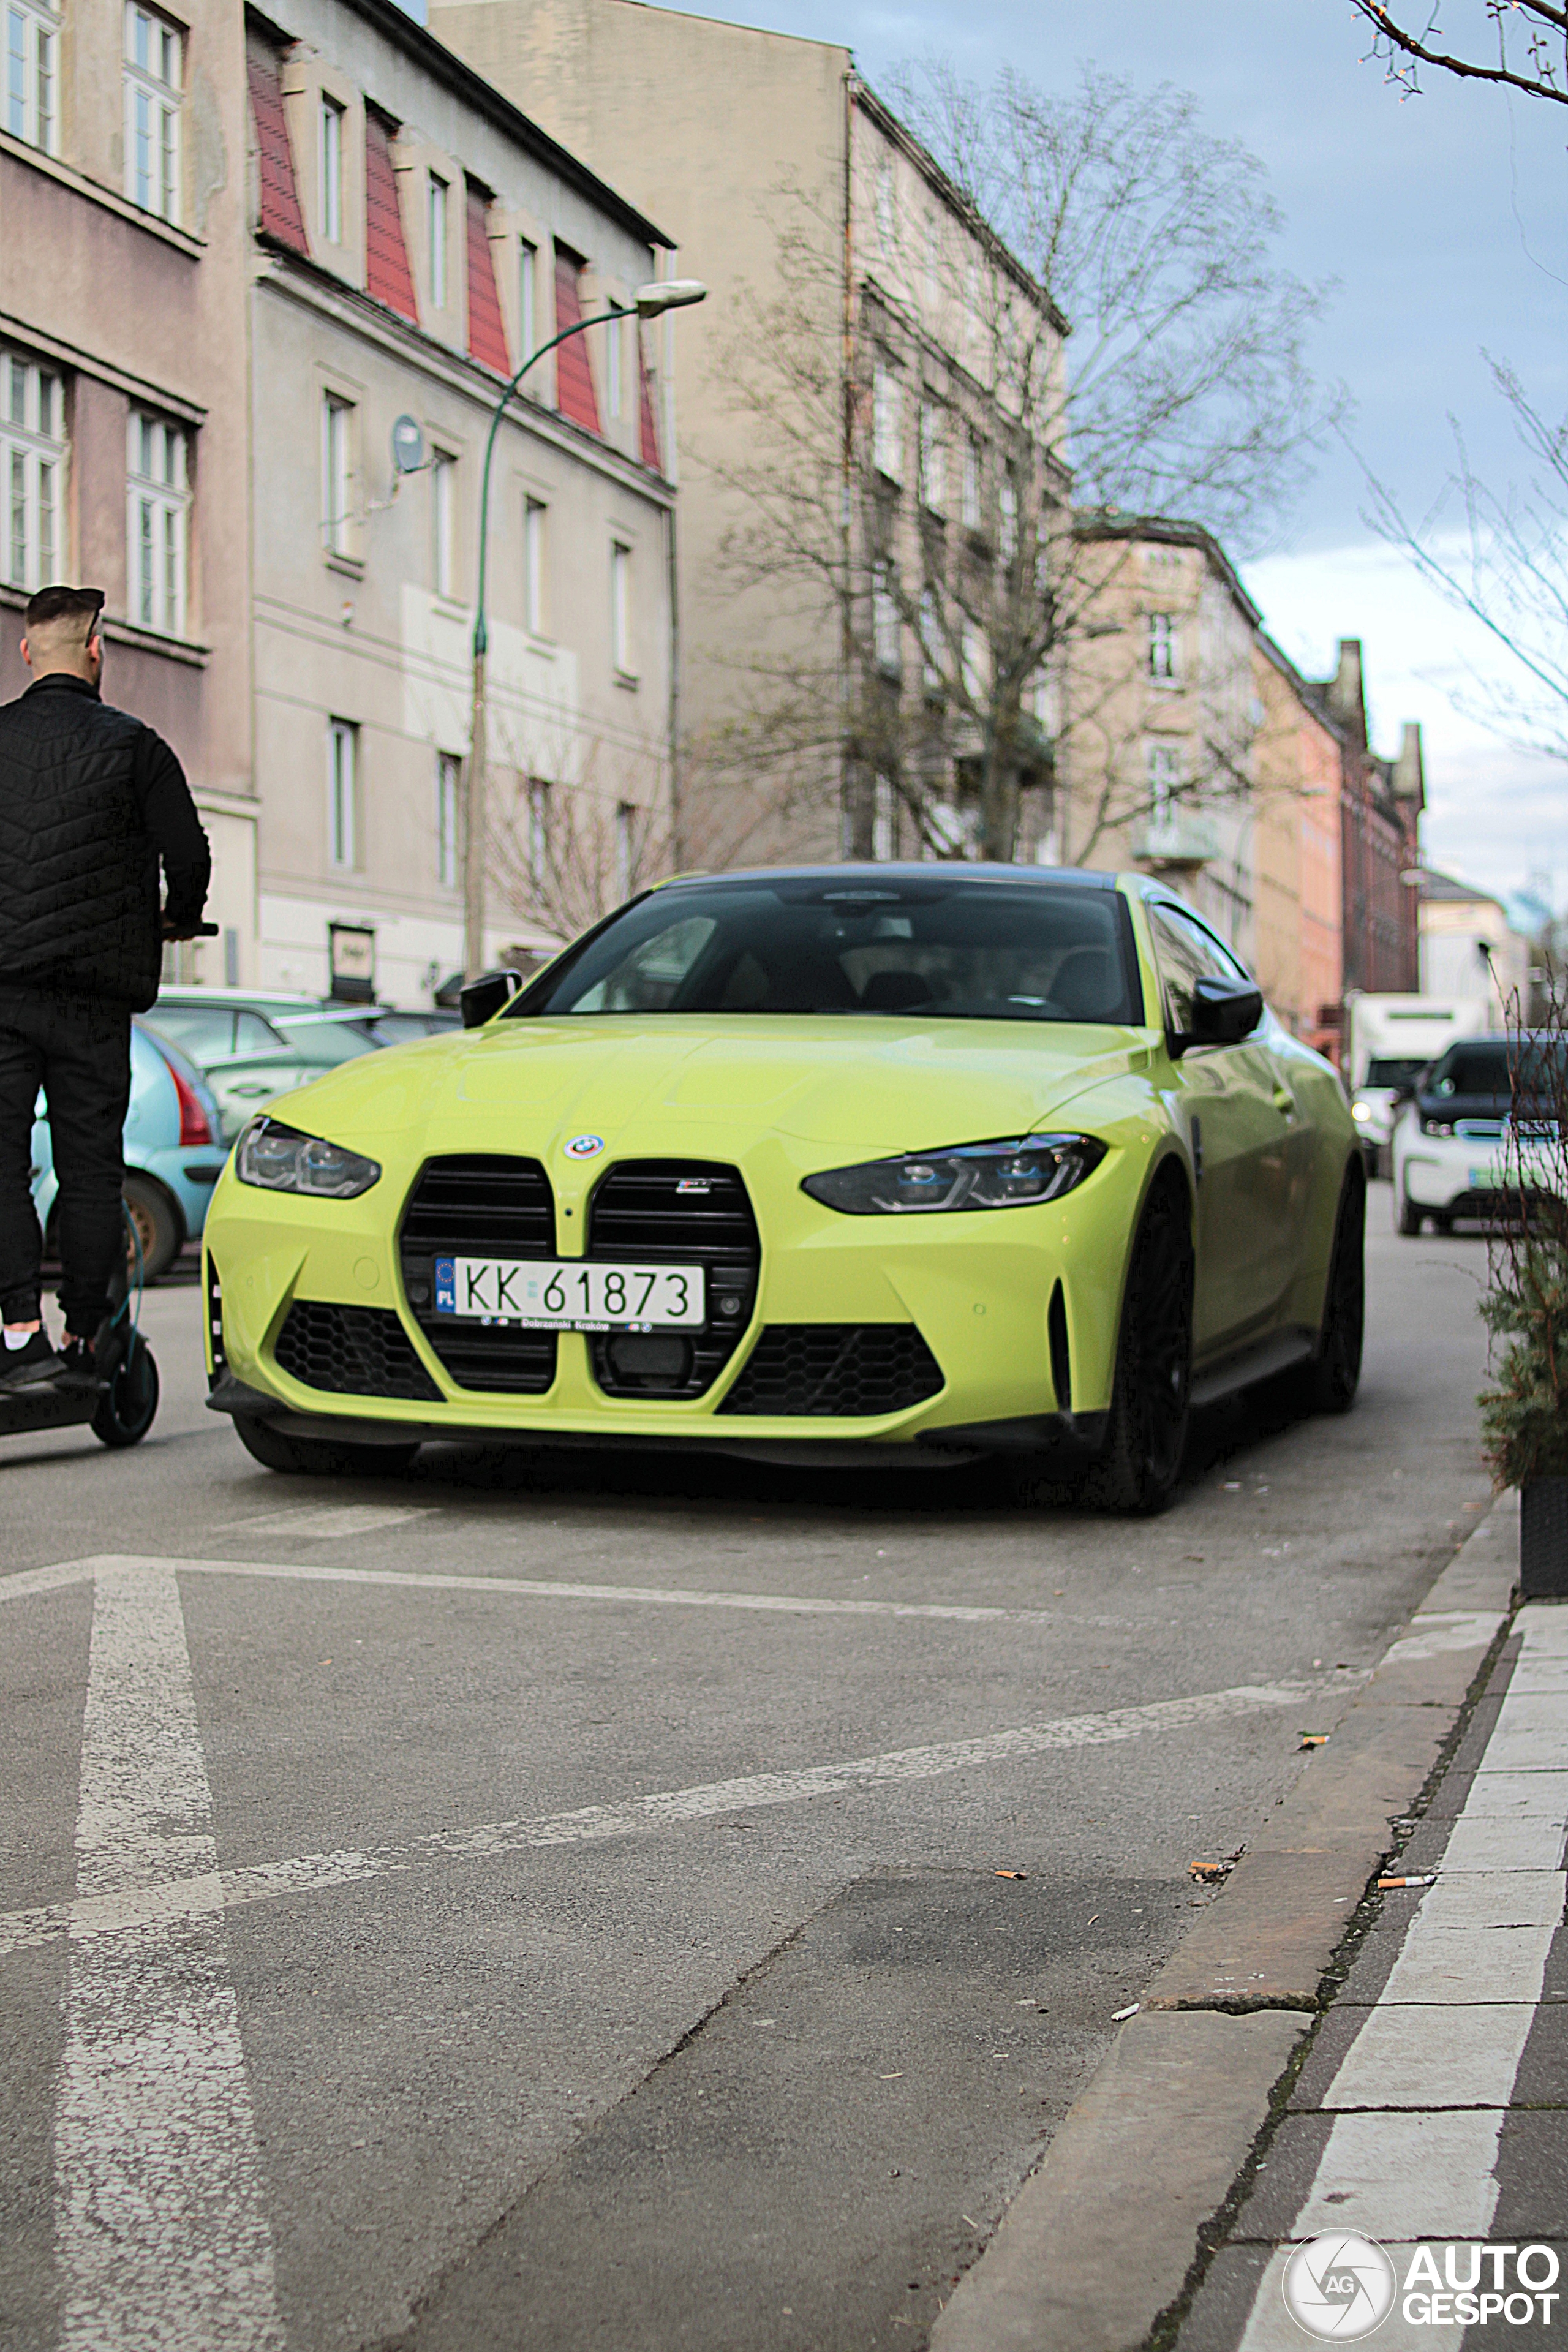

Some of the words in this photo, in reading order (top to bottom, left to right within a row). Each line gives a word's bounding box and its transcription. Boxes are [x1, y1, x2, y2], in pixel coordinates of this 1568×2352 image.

[438, 1290, 454, 1305] PL
[466, 1265, 521, 1311] KK
[544, 1269, 688, 1317] 61873
[522, 1318, 571, 1329] Dobrzański
[576, 1321, 609, 1330] Kraków
